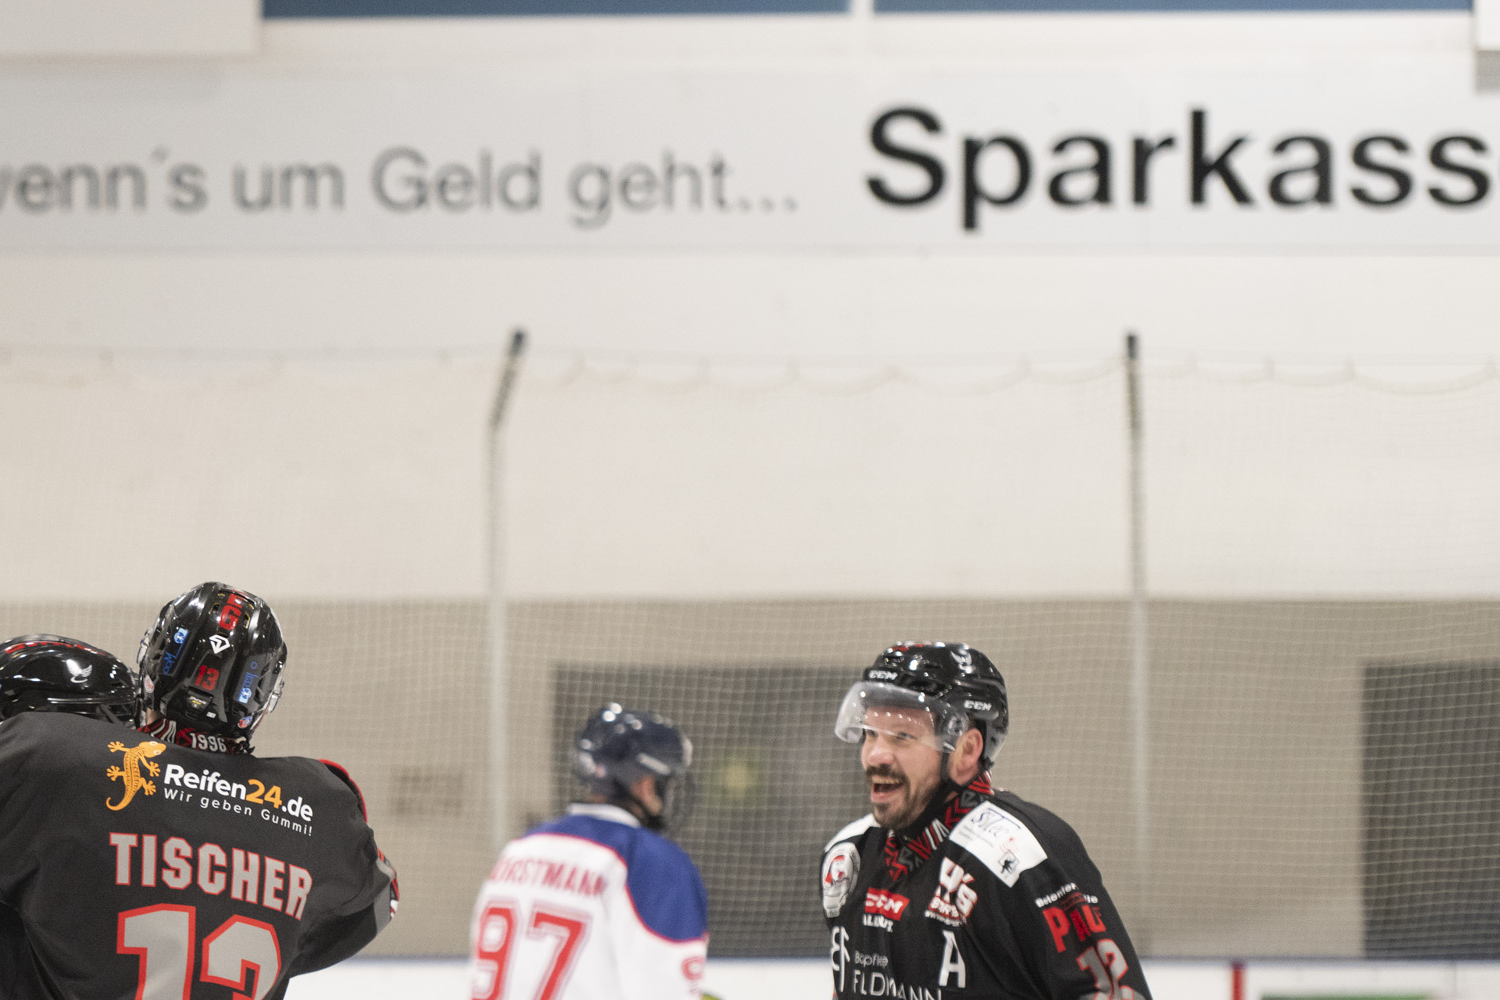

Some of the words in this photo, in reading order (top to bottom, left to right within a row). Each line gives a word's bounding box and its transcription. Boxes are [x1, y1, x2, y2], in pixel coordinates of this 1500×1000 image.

[232, 160, 347, 215] um
[371, 146, 542, 215] Geld
[964, 701, 992, 711] CCM
[190, 732, 227, 753] 1996
[164, 763, 313, 822] Reifen24.de
[164, 787, 192, 802] Wir
[200, 796, 252, 816] geben
[261, 809, 313, 837] Gummi!
[109, 832, 313, 921] TISCHER
[939, 930, 966, 989] A
